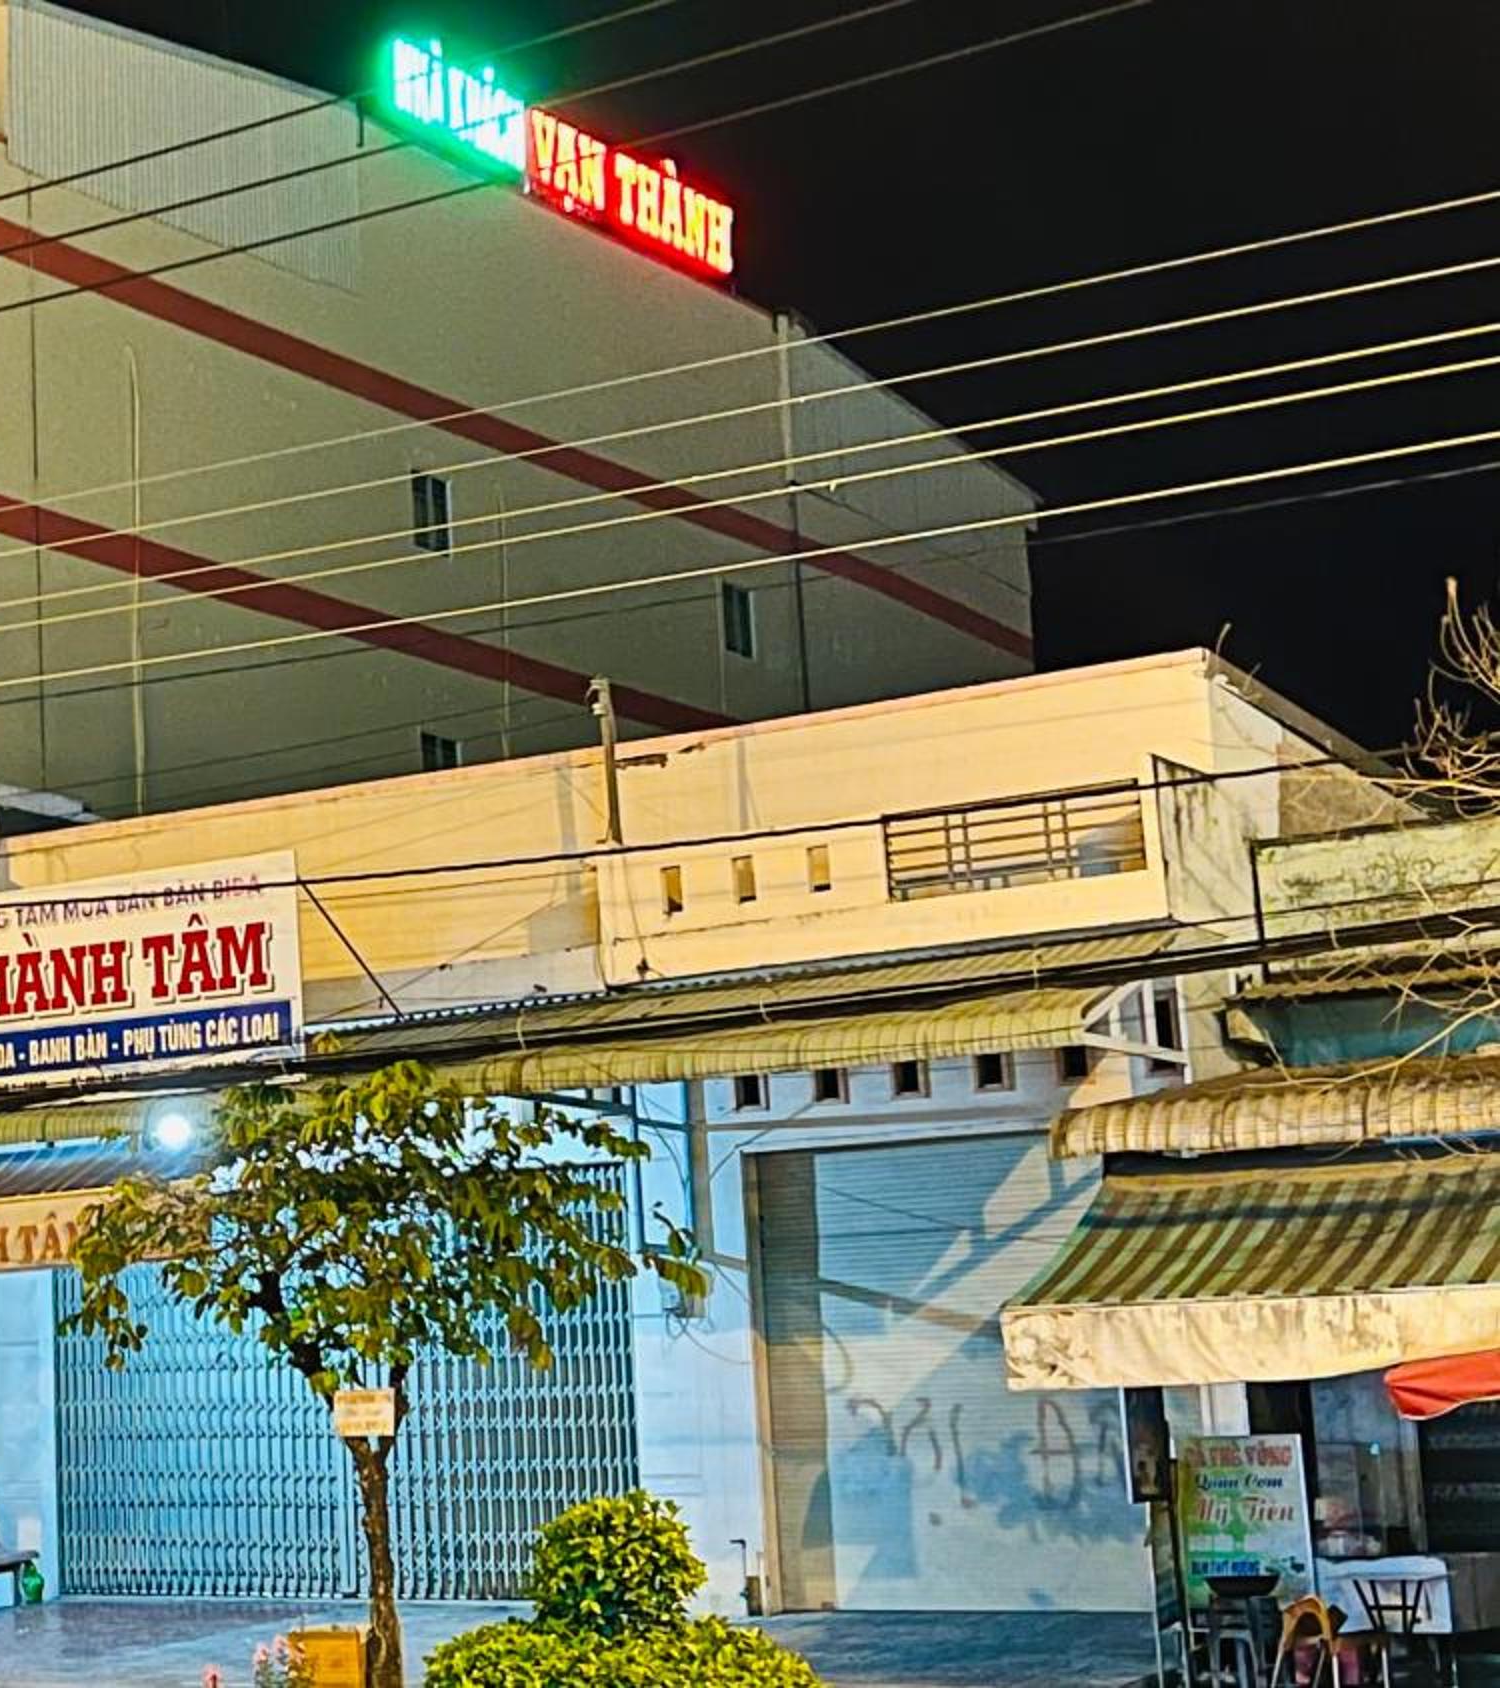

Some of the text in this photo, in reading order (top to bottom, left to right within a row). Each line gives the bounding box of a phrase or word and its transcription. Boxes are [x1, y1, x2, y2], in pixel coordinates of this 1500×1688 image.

[531, 108, 734, 274] VẠN THÀNH
[63, 900, 109, 919] MUA
[142, 912, 270, 1000] TÂM
[29, 1035, 71, 1066] BANH
[75, 1027, 108, 1060] BÀN
[123, 1026, 155, 1061] PHỤ
[158, 1018, 201, 1053] TÙNG
[205, 1012, 238, 1047] CÁC
[241, 1012, 280, 1043] LOẠI
